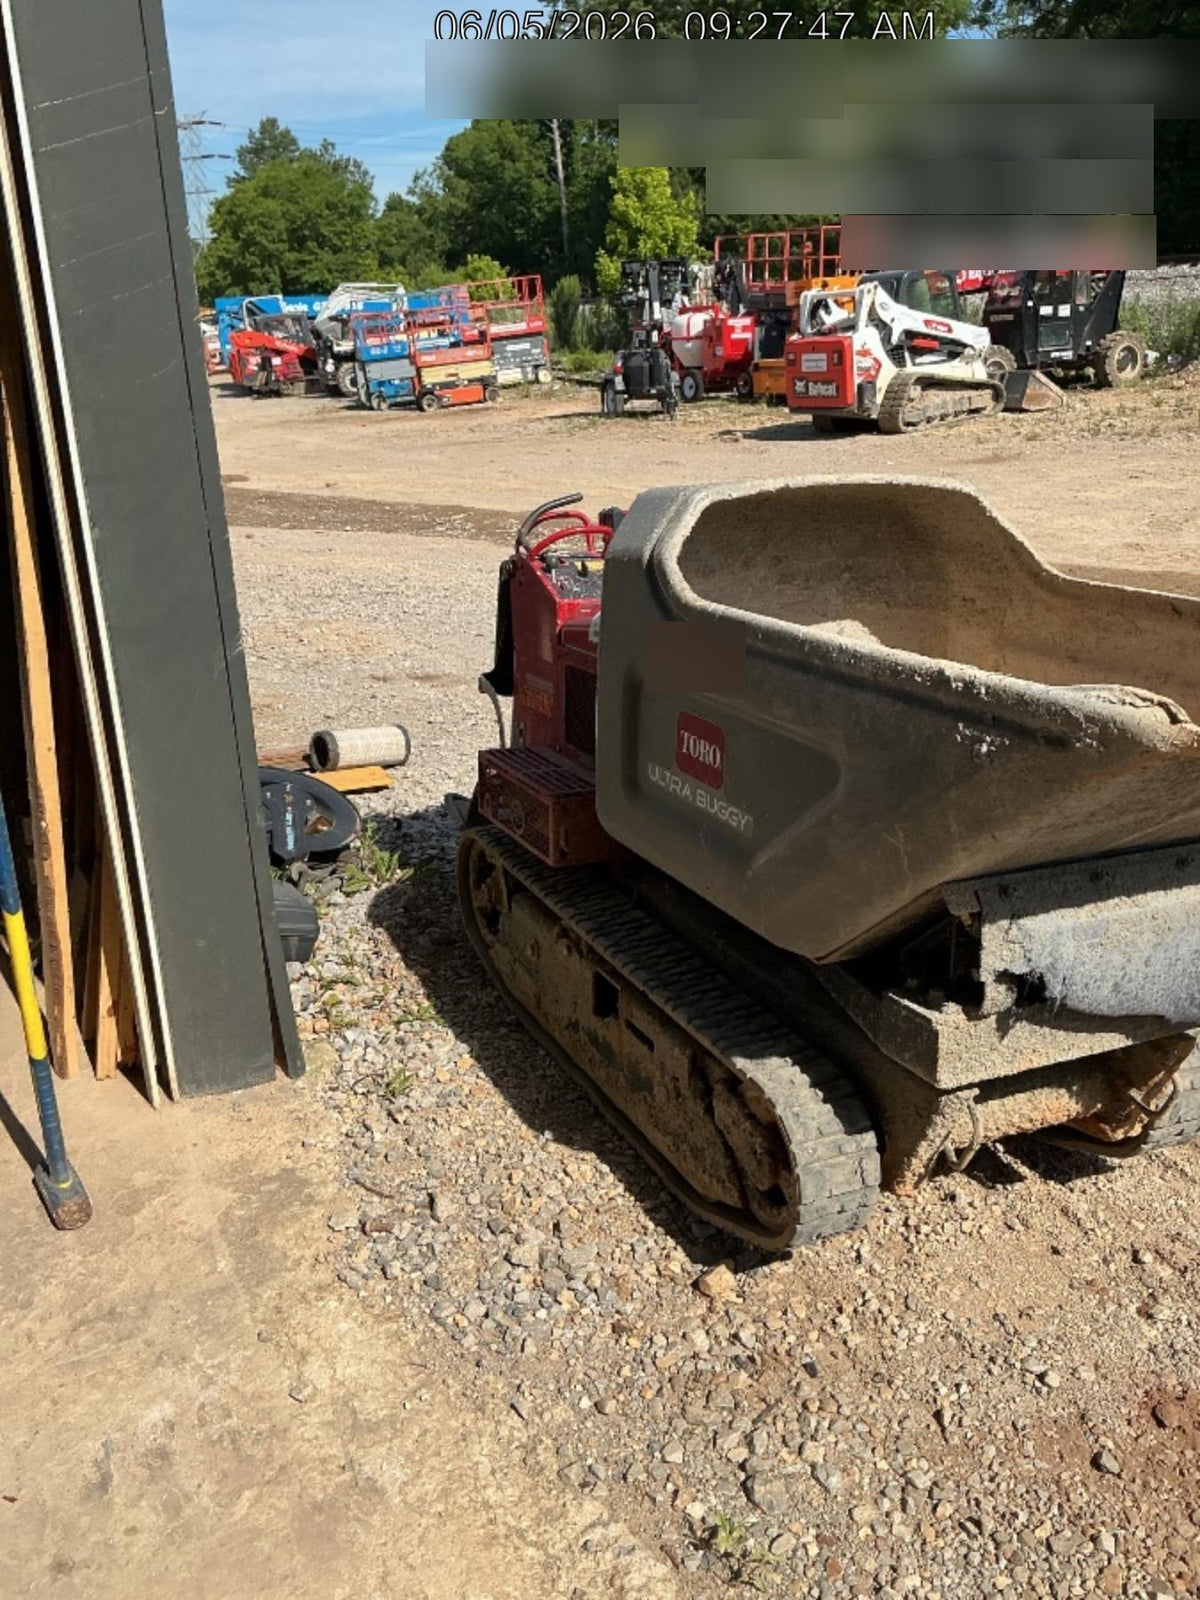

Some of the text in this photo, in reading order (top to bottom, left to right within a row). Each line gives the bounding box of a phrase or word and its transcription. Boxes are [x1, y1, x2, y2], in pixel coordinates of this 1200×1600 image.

[680, 730, 721, 768] TORO
[648, 762, 748, 831] ULTRA BUGGY
